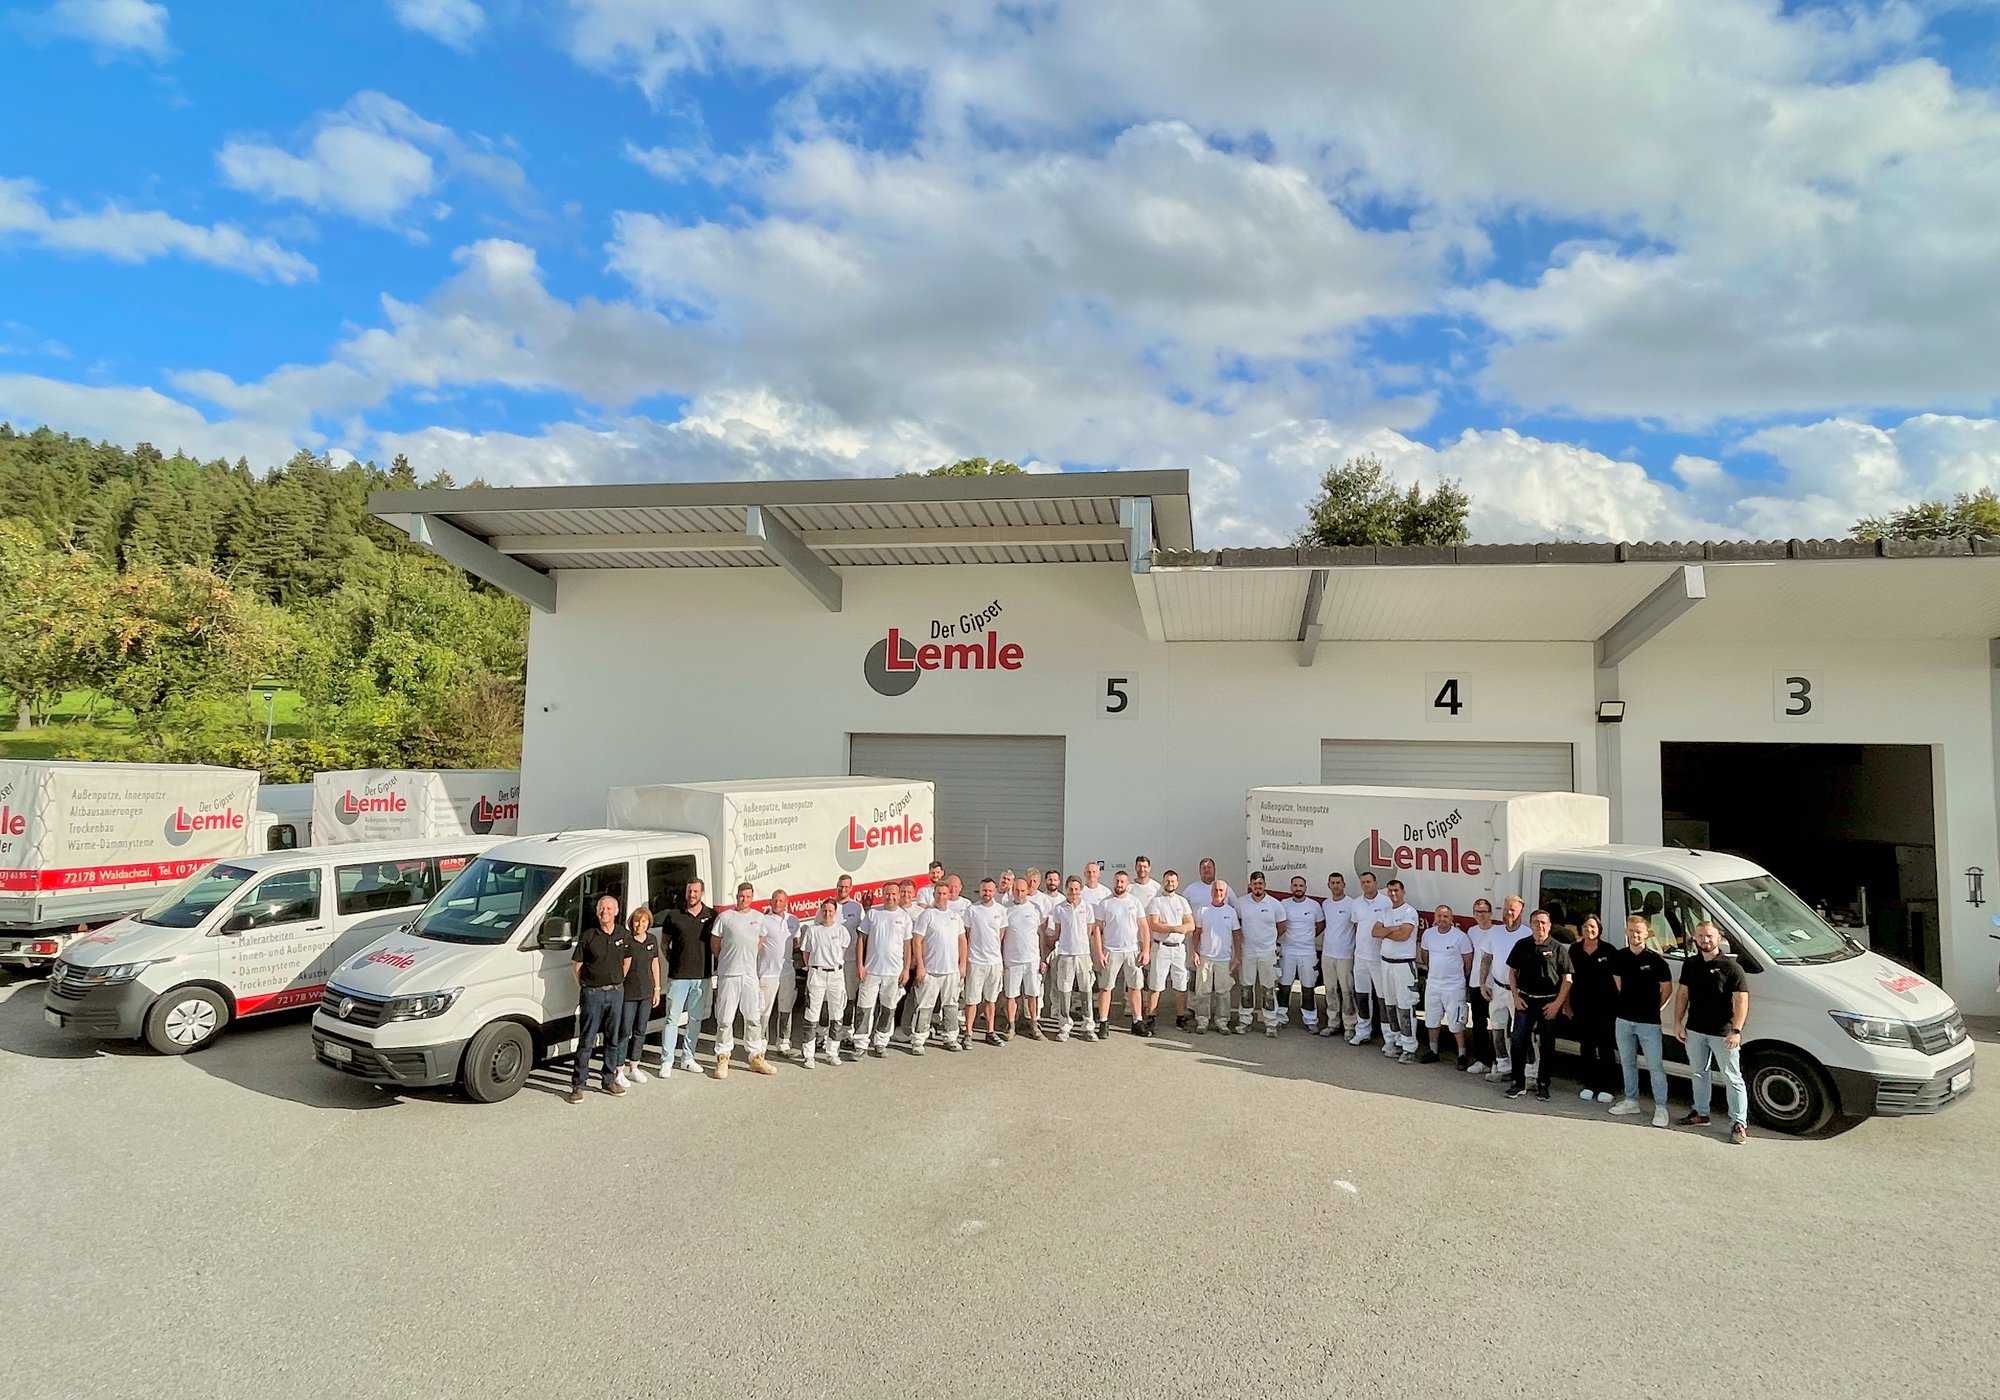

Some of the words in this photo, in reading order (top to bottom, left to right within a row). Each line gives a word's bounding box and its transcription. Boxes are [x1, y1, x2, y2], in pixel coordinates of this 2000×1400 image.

[930, 620, 956, 639] Der
[959, 599, 1003, 634] Gipser
[886, 628, 1025, 671] Lemle
[1106, 678, 1128, 713] 5
[1434, 679, 1463, 715] 4
[1785, 677, 1812, 716] 3
[72, 789, 121, 803] Außenputze,
[125, 789, 166, 803] Innenputze
[365, 786, 376, 796] Der
[378, 775, 398, 794] Gipser
[499, 790, 509, 801] Der
[199, 801, 212, 812] Der
[214, 790, 235, 809] Gipser
[345, 789, 407, 813] Lemle
[782, 800, 814, 812] Innenputze
[873, 807, 887, 823] Der
[889, 790, 913, 818] Gipser
[70, 806, 143, 819] Altbausanierungen
[176, 806, 244, 830] Lemle
[743, 815, 798, 828] Altbausanierungen
[69, 823, 114, 834] Trockenbau
[743, 829, 777, 842] Trockenbau
[848, 814, 924, 851] Lemle
[1403, 823, 1424, 842] Der
[1427, 808, 1462, 839] Gipser
[67, 838, 154, 851] Wärme-Dämmsysteme
[1370, 828, 1482, 876] Lemle
[64, 871, 96, 884] 72178
[158, 865, 173, 876] Tel.
[238, 931, 294, 946] Malerarbeiten
[367, 947, 416, 969] Lemle
[240, 976, 288, 990] Trockenbau
[298, 968, 328, 980] Akustik
[277, 993, 306, 1005] 72178
